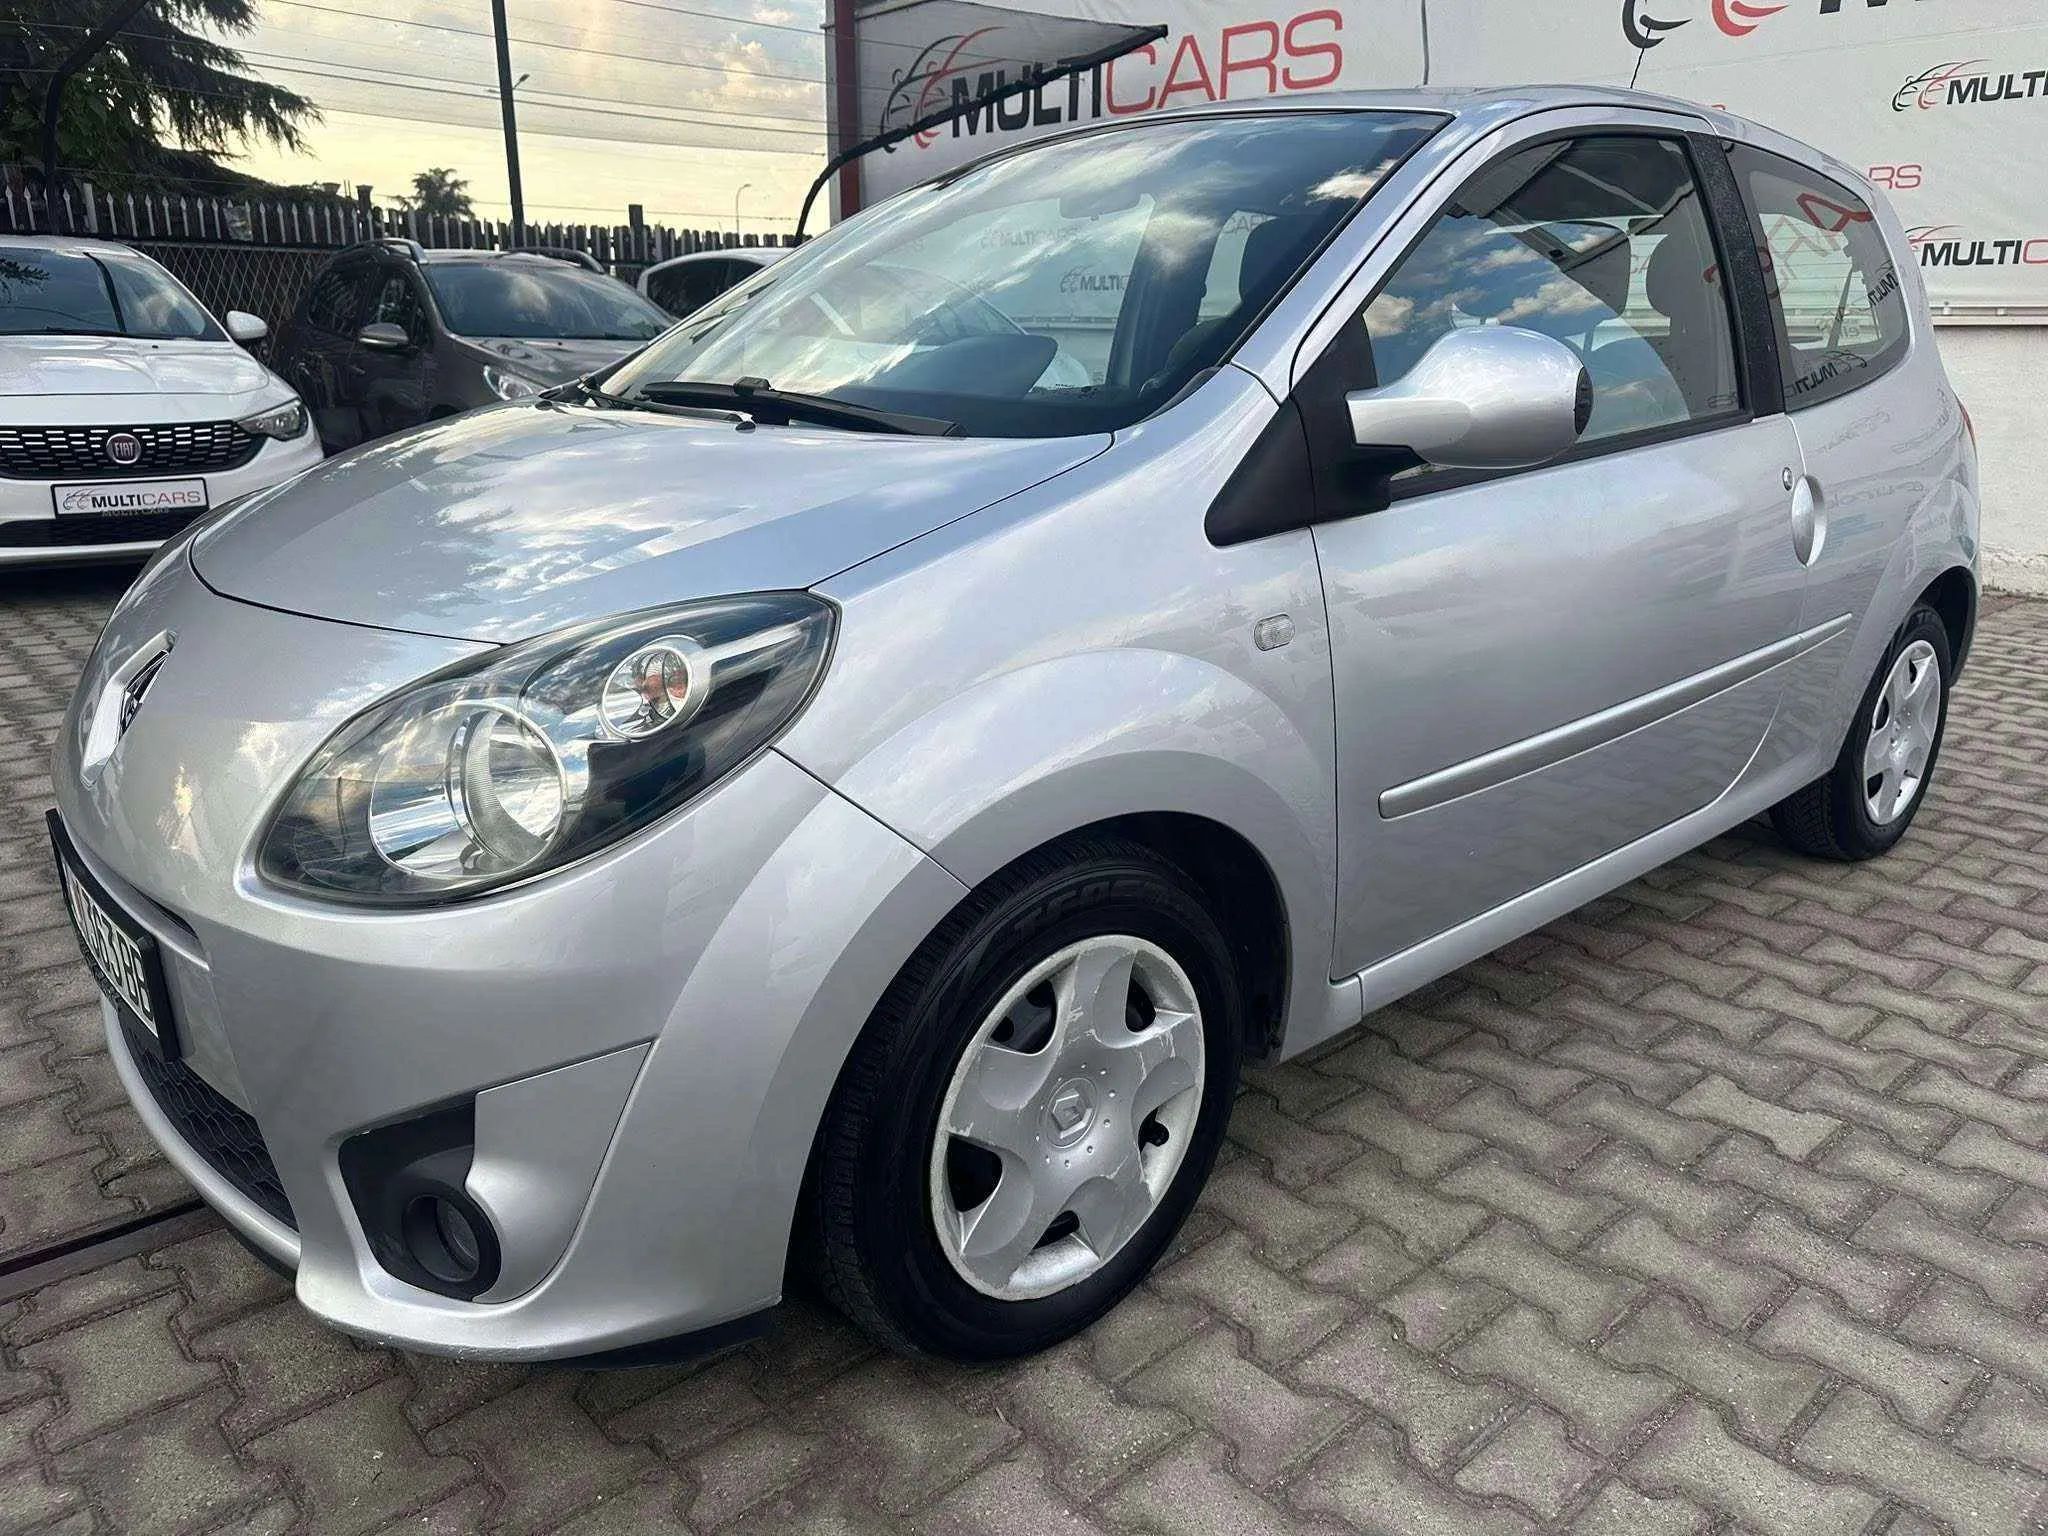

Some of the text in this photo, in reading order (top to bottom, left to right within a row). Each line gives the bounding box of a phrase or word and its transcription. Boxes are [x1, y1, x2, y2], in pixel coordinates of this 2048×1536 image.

[952, 10, 1343, 138] MULTICARS
[114, 441, 134, 457] FIAT
[91, 491, 201, 509] MULTICARS
